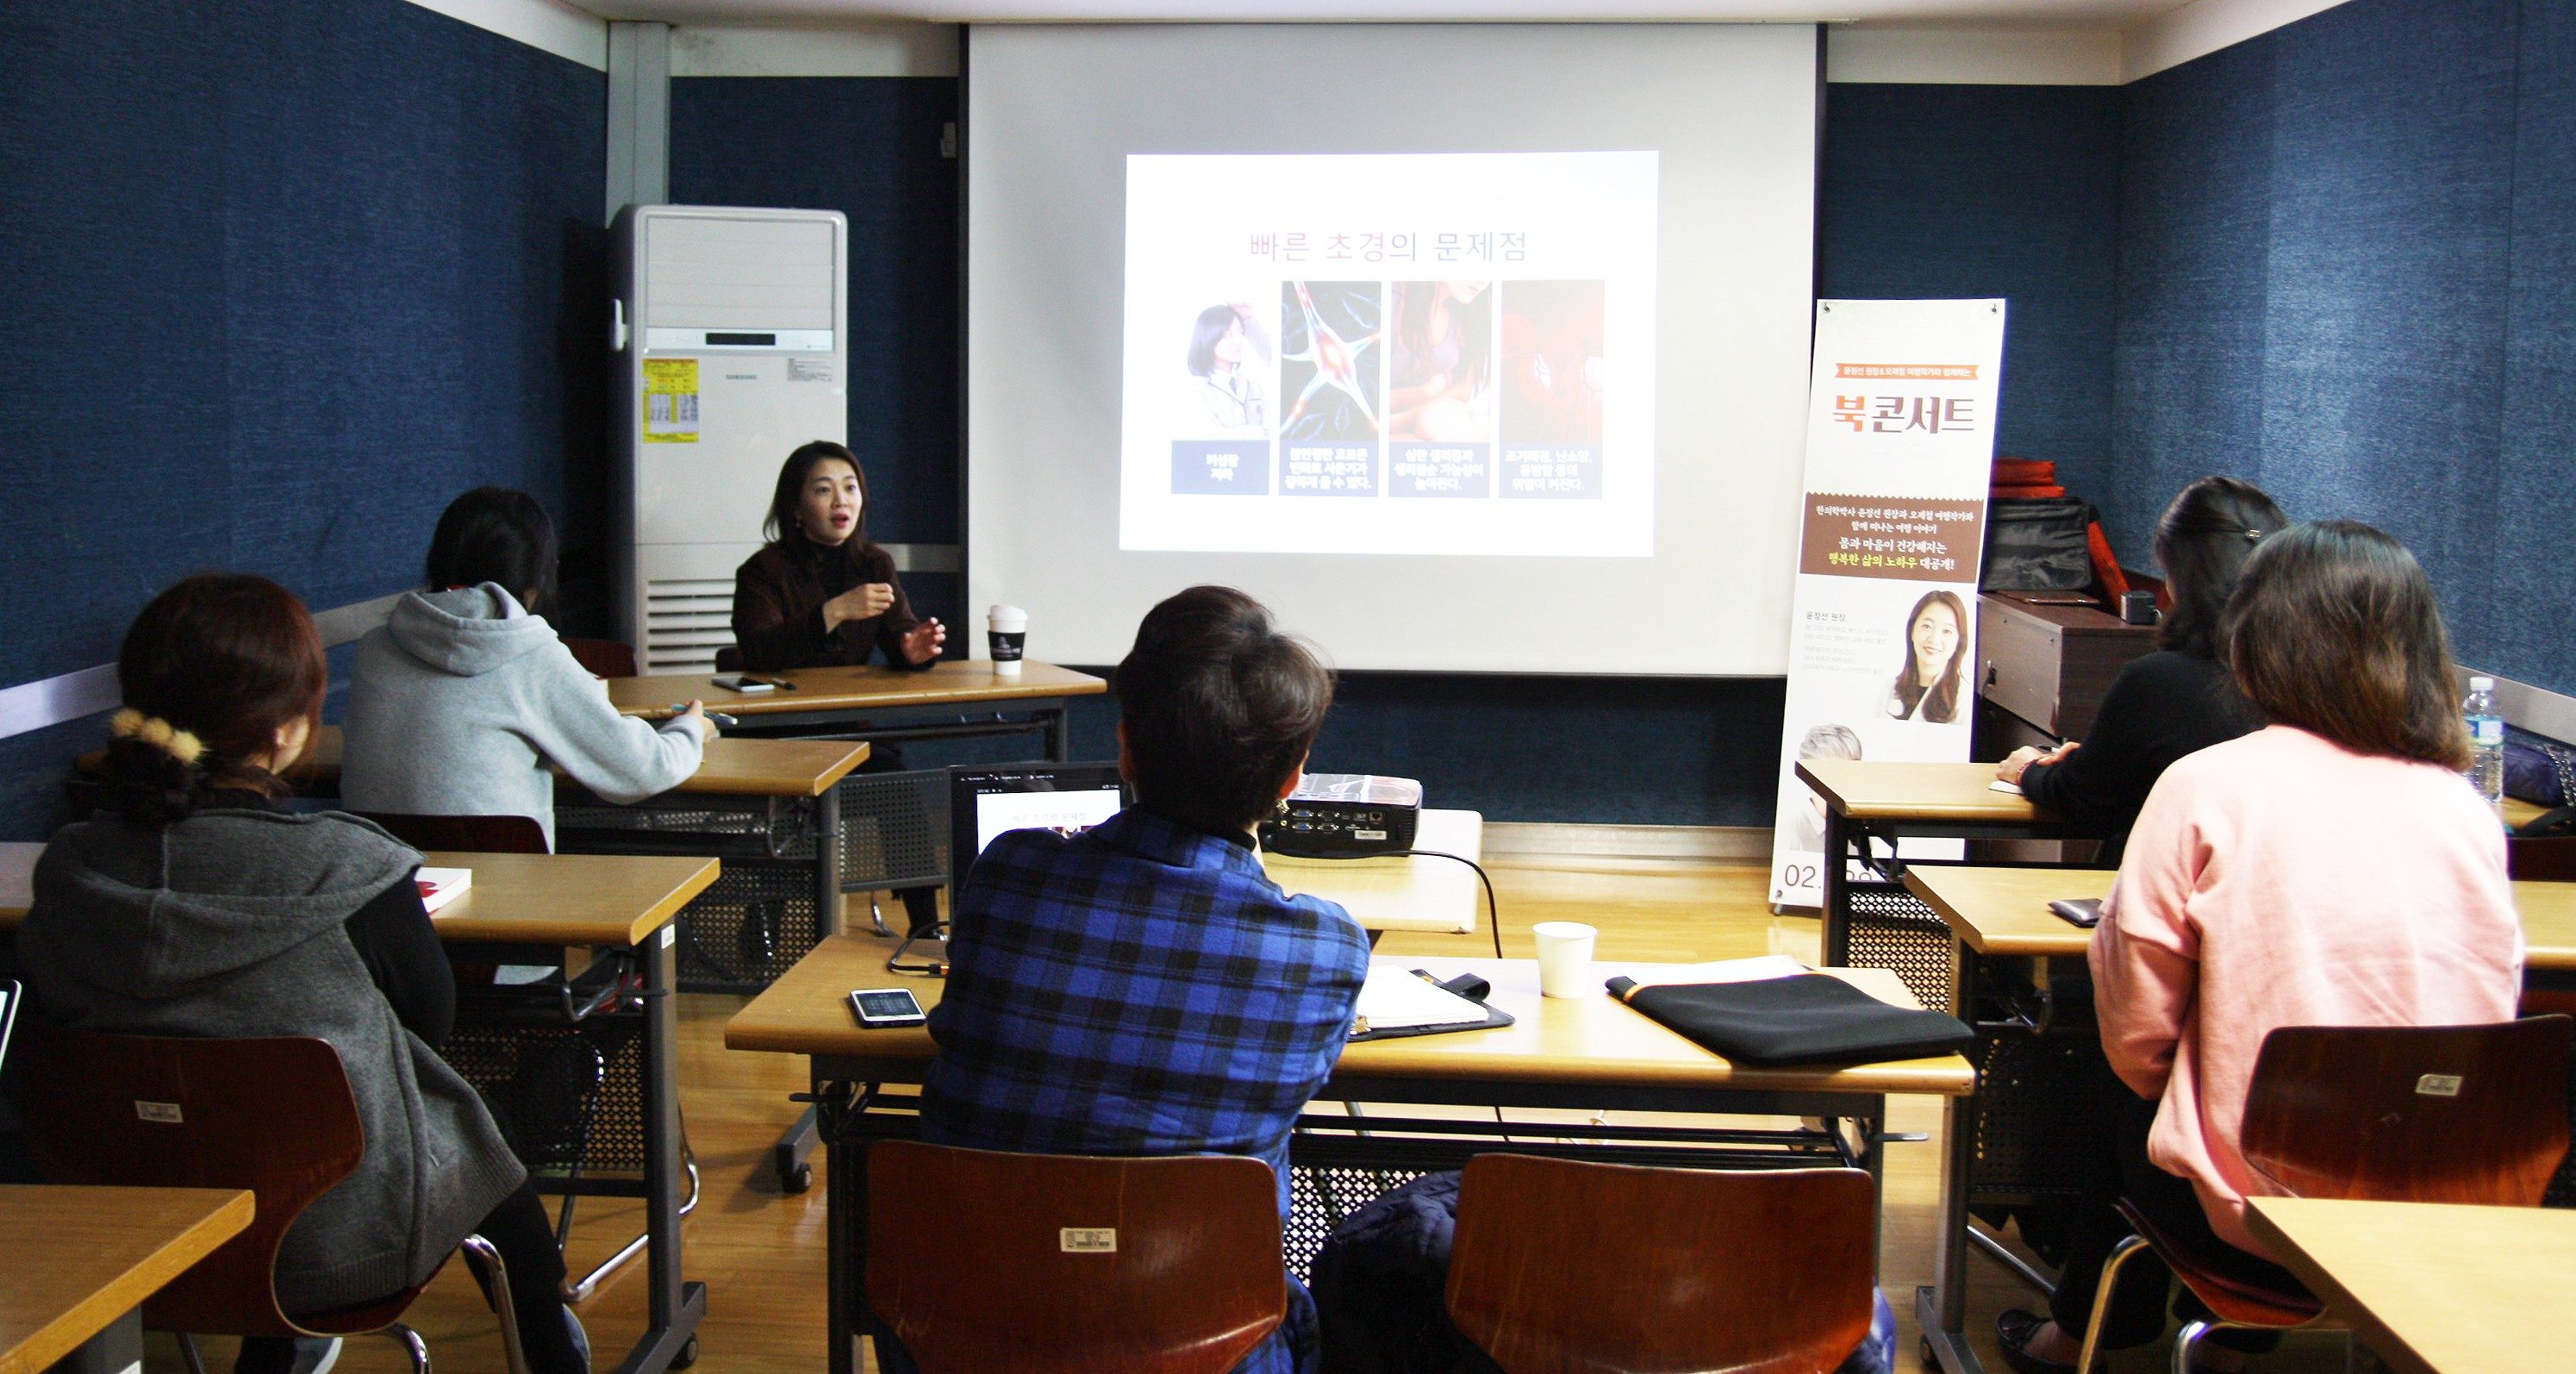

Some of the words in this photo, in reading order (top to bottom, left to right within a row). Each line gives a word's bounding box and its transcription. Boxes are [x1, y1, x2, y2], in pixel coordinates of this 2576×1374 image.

[1250, 232, 1310, 262] 빠른
[1325, 232, 1416, 262] 초경의
[1433, 232, 1525, 262] 문제점
[1913, 524, 1938, 534] 이야기
[1838, 536, 1862, 550] 몸과
[1862, 538, 1894, 552] 마음이
[1896, 539, 1948, 554] 건강해지는
[1828, 552, 1860, 566] 행복한
[1862, 553, 1883, 567] 삶의
[1885, 555, 1918, 569] 노하우
[1919, 556, 1955, 571] 대공개!
